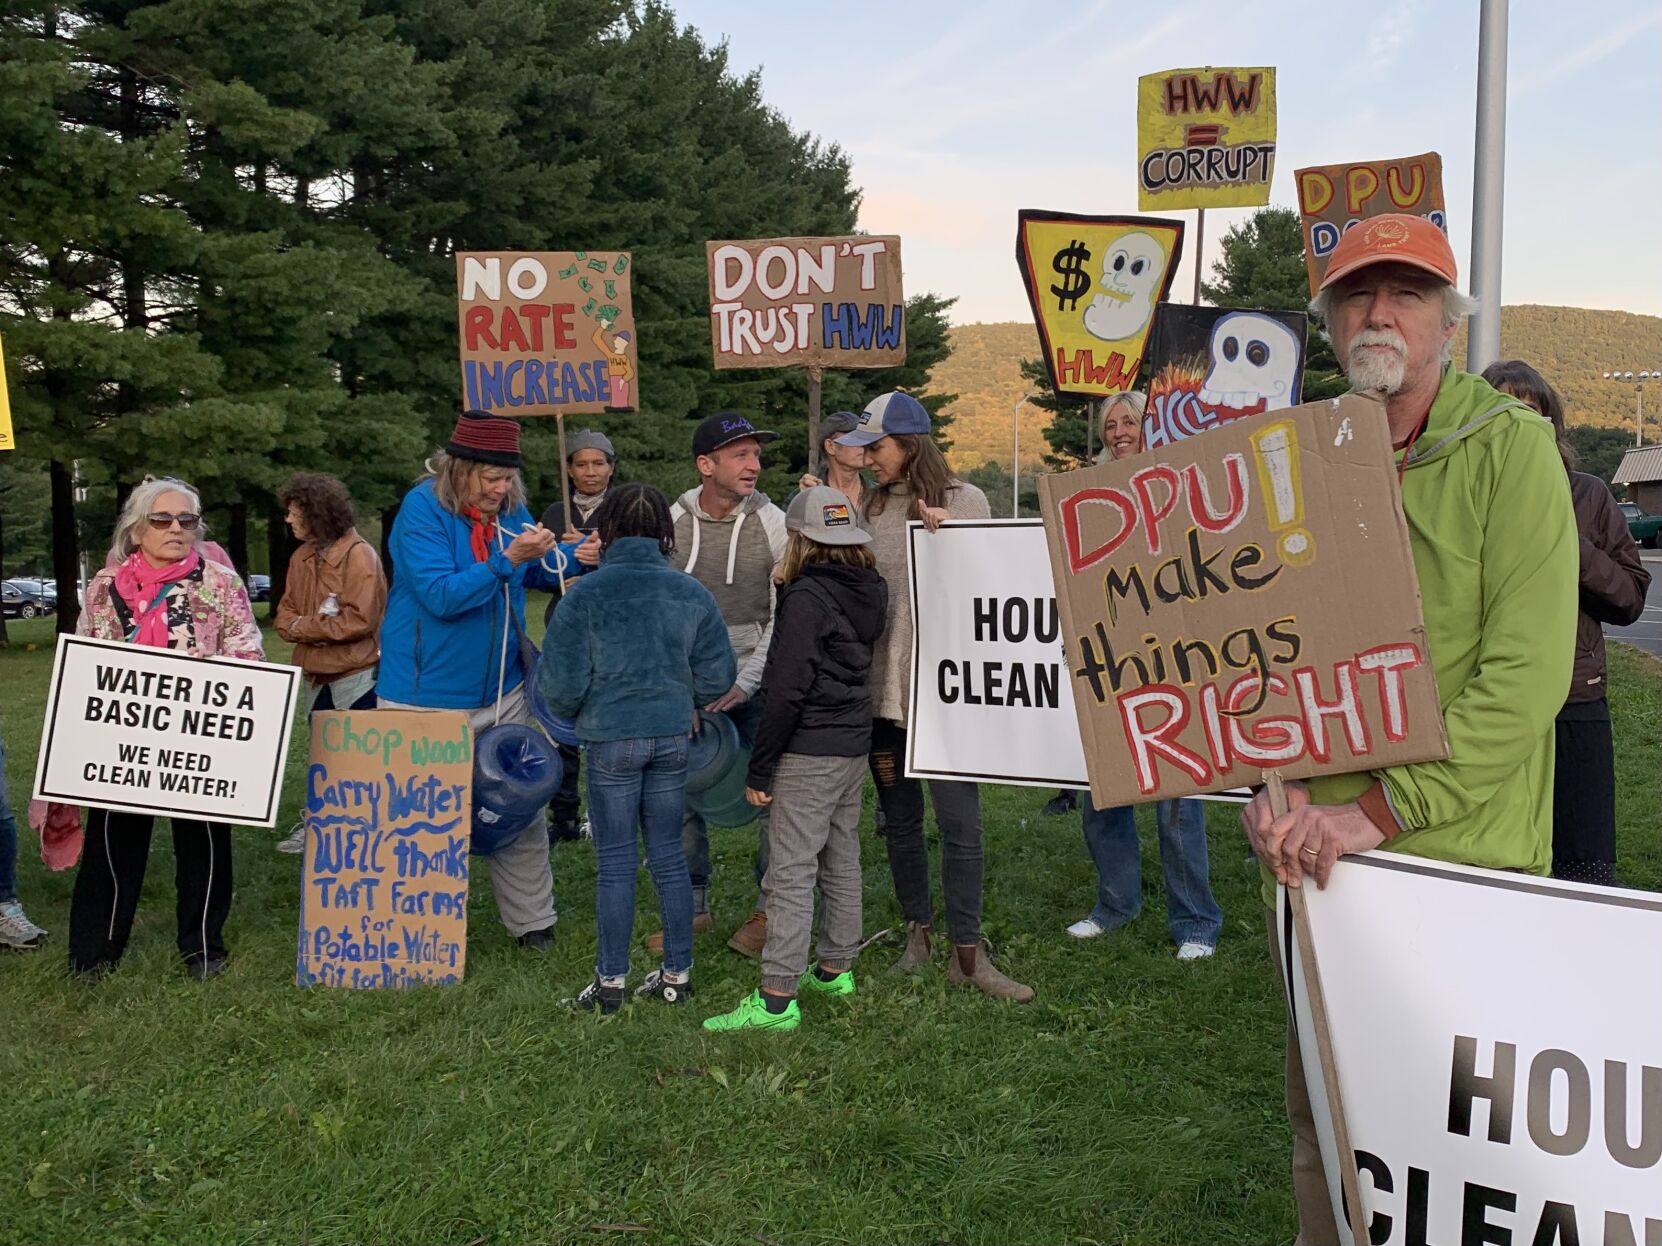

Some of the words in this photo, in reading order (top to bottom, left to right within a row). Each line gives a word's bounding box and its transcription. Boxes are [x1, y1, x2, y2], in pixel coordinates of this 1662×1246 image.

[1165, 72, 1262, 114] HWW
[1141, 143, 1275, 191] CORRUPT
[1300, 163, 1426, 217] DPU
[461, 256, 548, 301] NO
[713, 240, 887, 301] DON'T
[464, 303, 577, 352] RATE
[711, 301, 815, 355] TRUST
[822, 302, 903, 351] HWW
[464, 358, 611, 411] INCREASE
[1056, 346, 1142, 393] HWW
[973, 596, 1059, 644] HOU
[96, 664, 194, 703] WATER
[202, 680, 230, 708] IS
[236, 686, 255, 712] A
[937, 658, 1060, 709] CLEAN
[1075, 615, 1301, 718] things
[84, 695, 172, 732] BASIC
[180, 709, 255, 742] NEED
[322, 715, 404, 768] Chop
[1116, 642, 1422, 794] RIGHT
[83, 762, 151, 789] CLEAN
[159, 772, 238, 799] WATER!
[118, 743, 151, 766] WE
[157, 749, 212, 773] NEED
[306, 763, 381, 832] Carry
[385, 772, 468, 822] Water
[314, 924, 400, 963] Potable
[402, 922, 461, 968] Water
[360, 915, 395, 933] for
